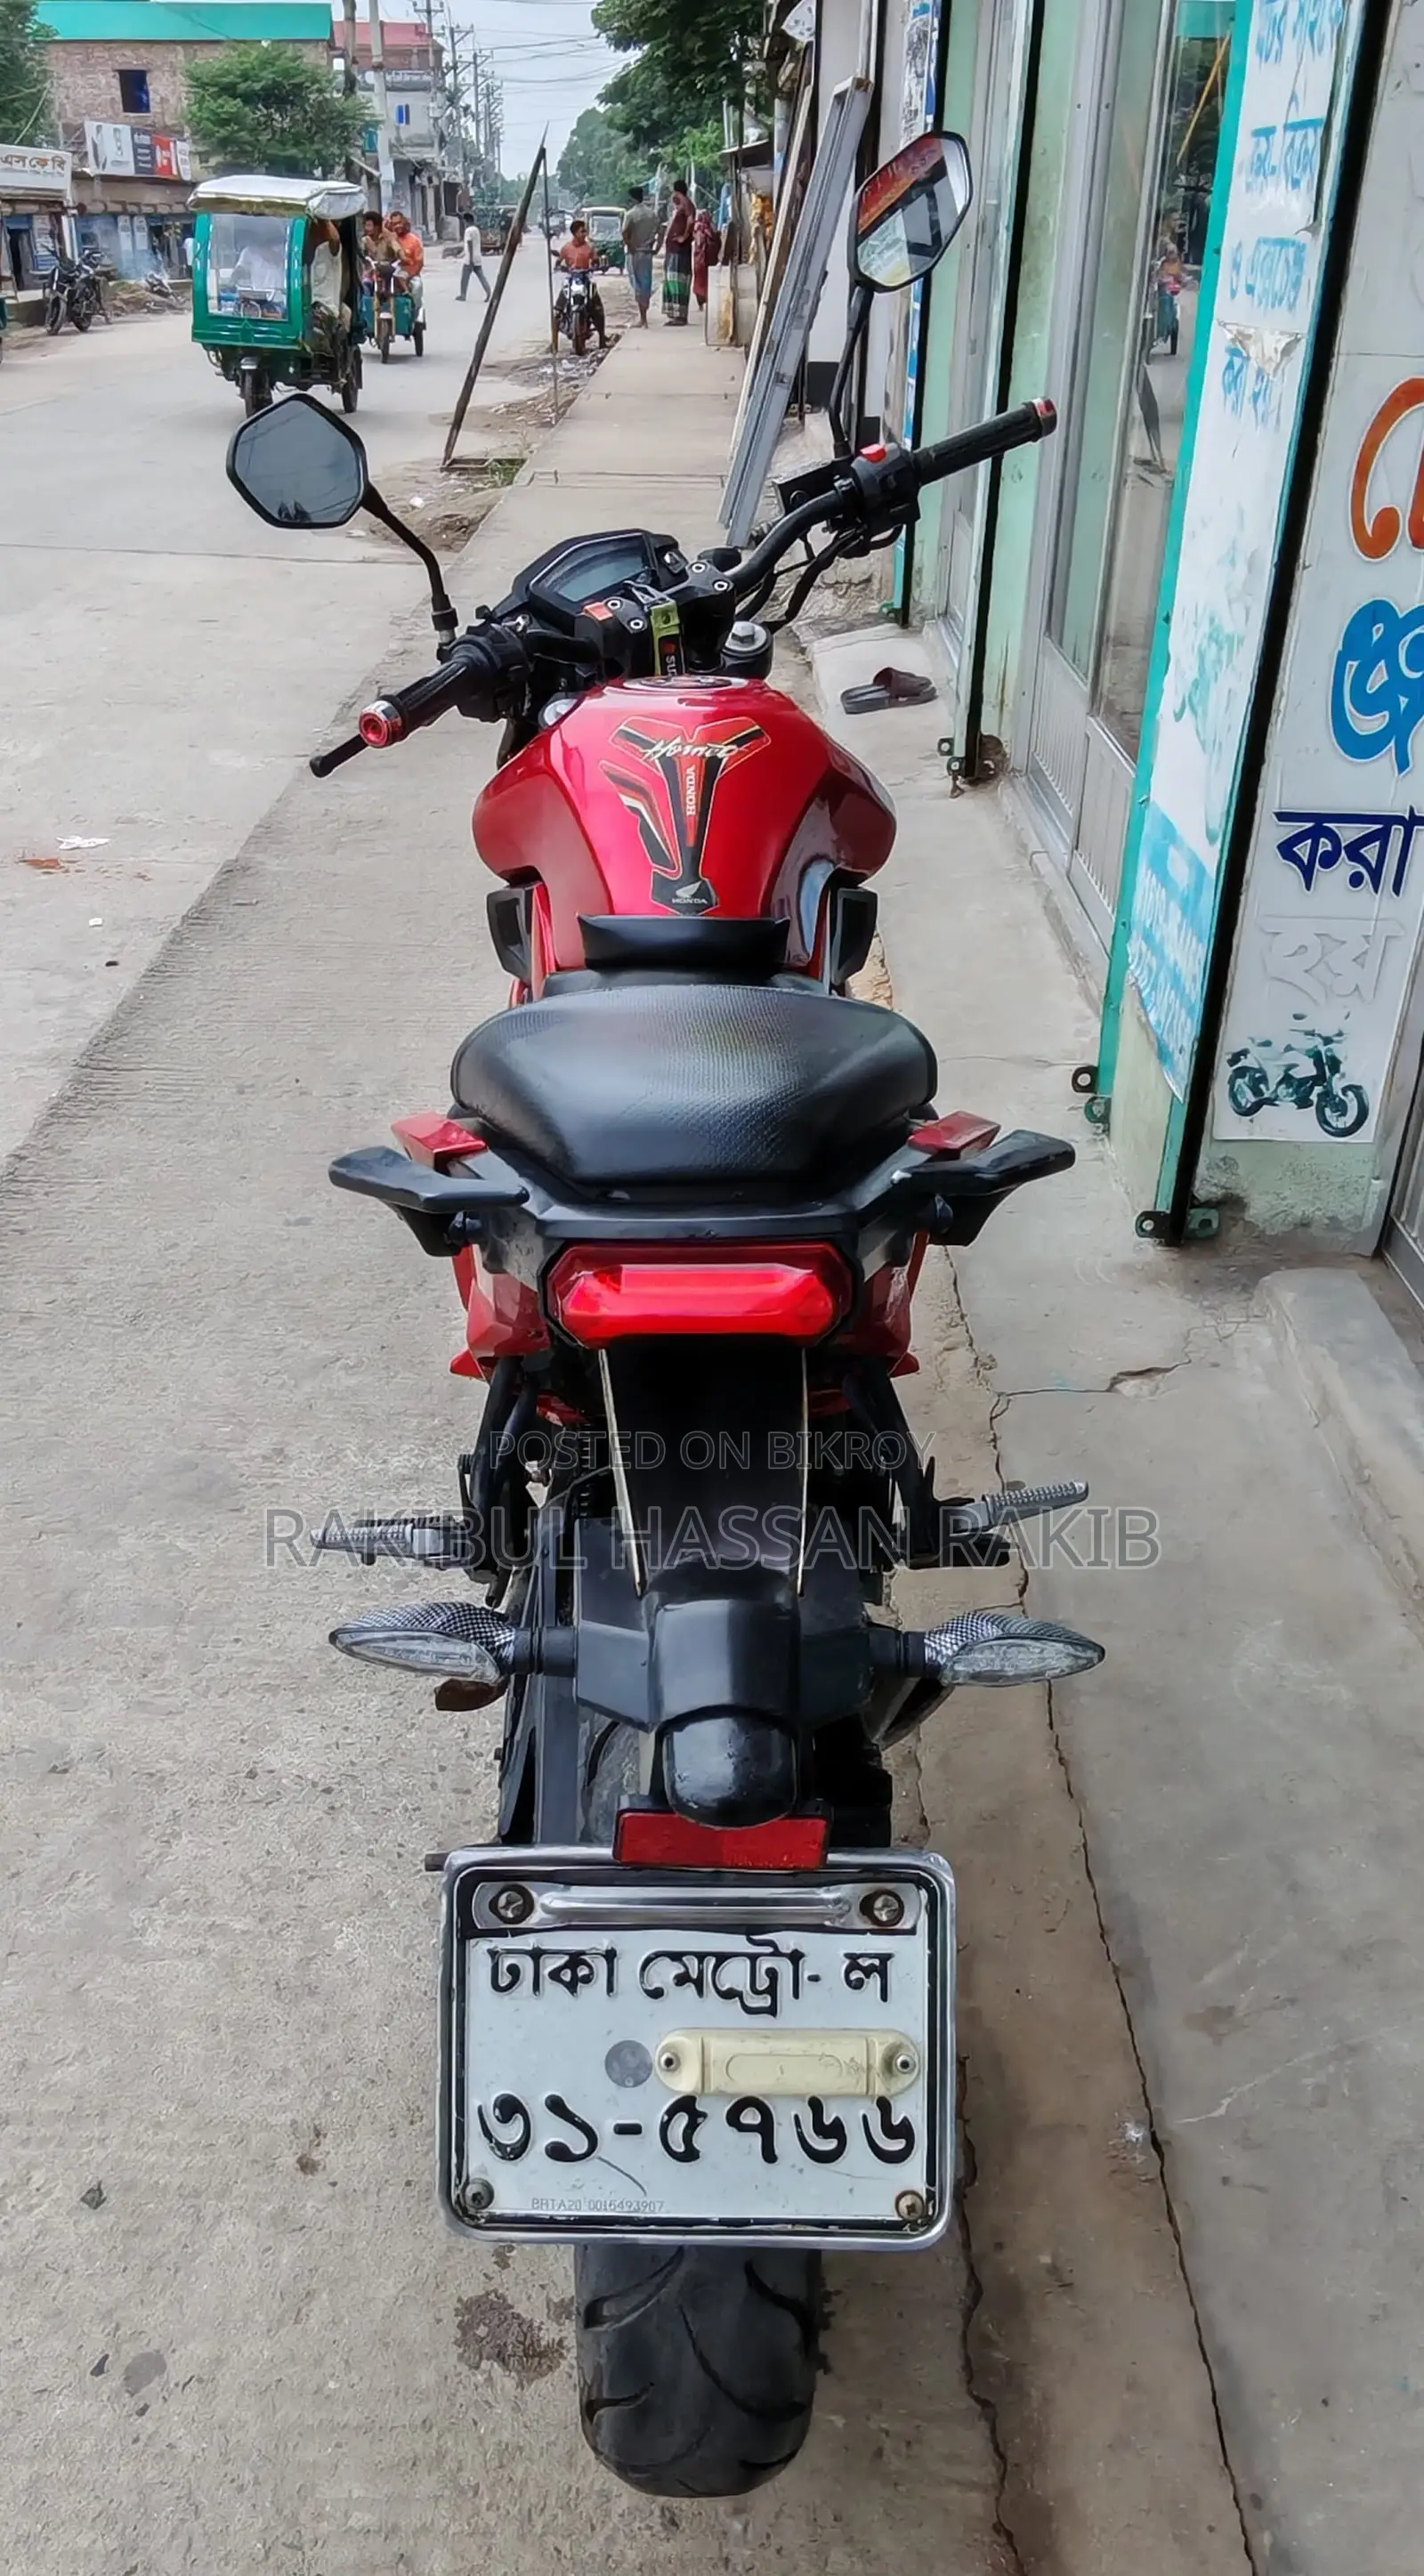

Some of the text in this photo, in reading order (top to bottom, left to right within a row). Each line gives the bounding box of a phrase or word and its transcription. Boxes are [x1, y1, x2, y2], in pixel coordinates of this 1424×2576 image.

[686, 764, 697, 816] HONDA
[1273, 804, 1424, 898] করা
[488, 1945, 617, 1997] ঢাকা
[844, 1951, 894, 2003] ল
[478, 2093, 916, 2166] ৩১-৫৭৬৬
